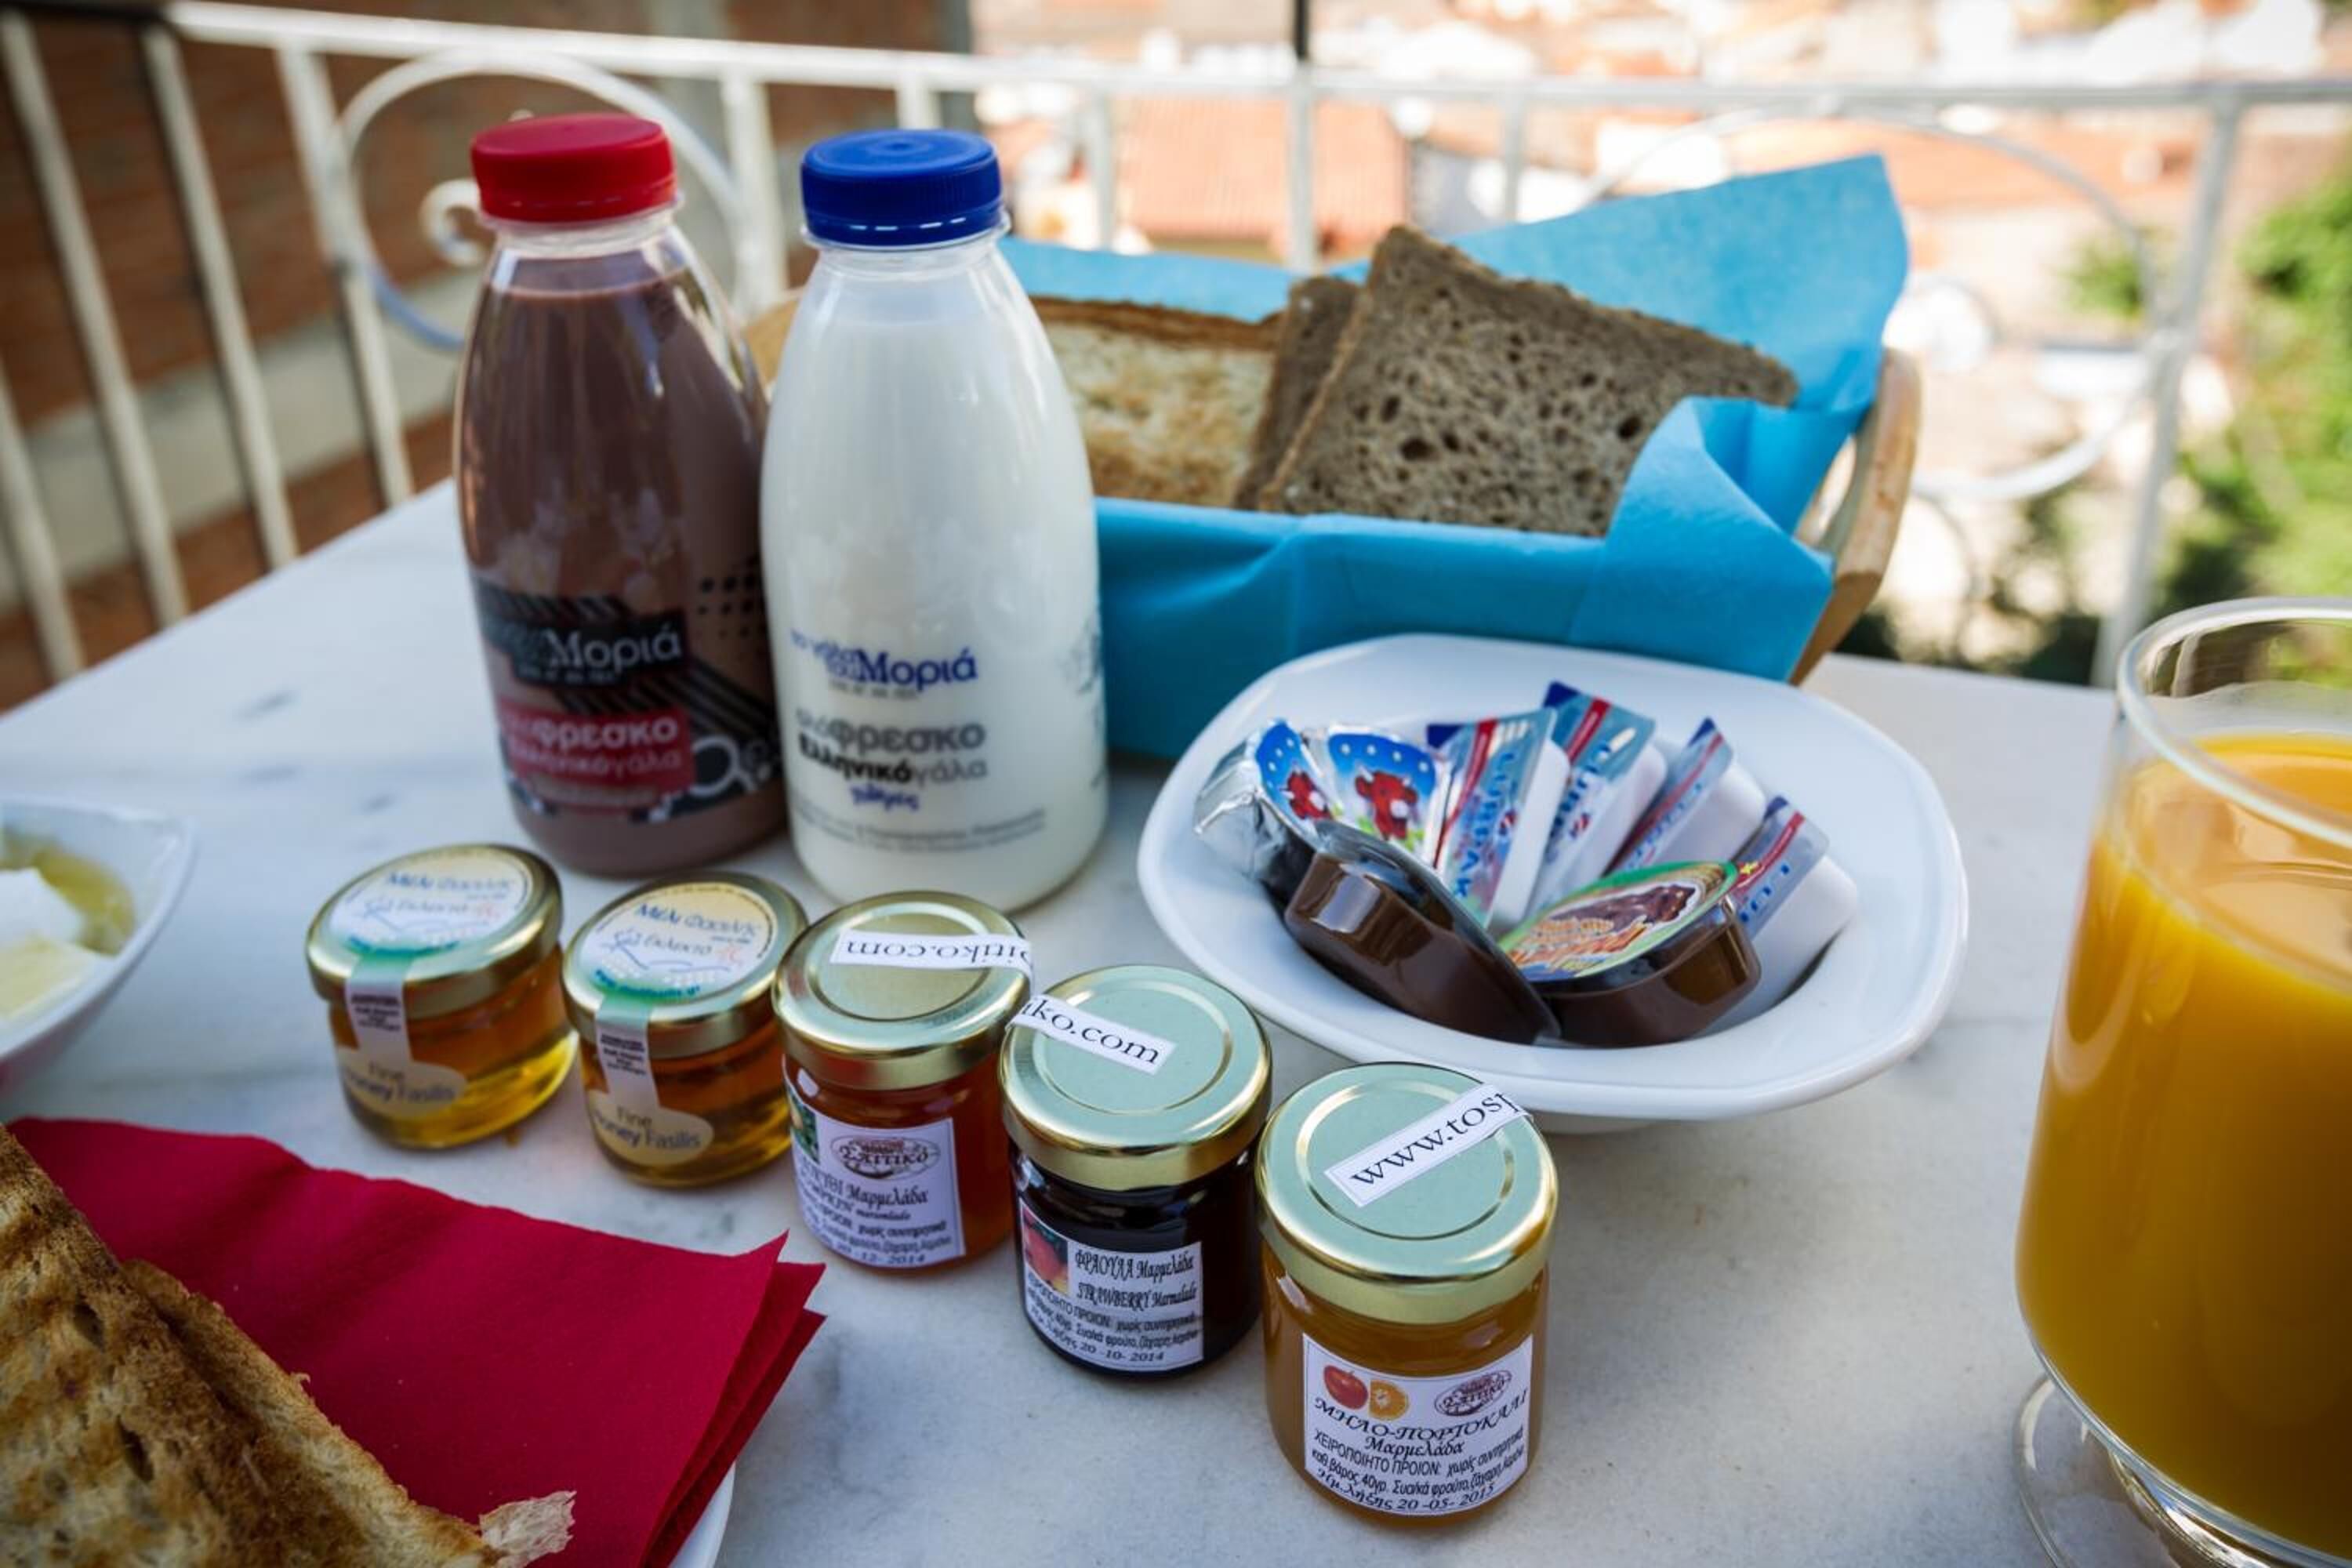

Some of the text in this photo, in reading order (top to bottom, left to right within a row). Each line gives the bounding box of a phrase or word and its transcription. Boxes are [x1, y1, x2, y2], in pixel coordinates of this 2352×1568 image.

[543, 622, 684, 676] Μοριά
[855, 644, 979, 693] Μοριά
[1130, 1351, 1165, 1362] 2014
[1314, 1428, 1391, 1473] ΧΕΙΡΟΠΟΙΗΤΟ
[1364, 1436, 1465, 1461] Μαρμελάδα
